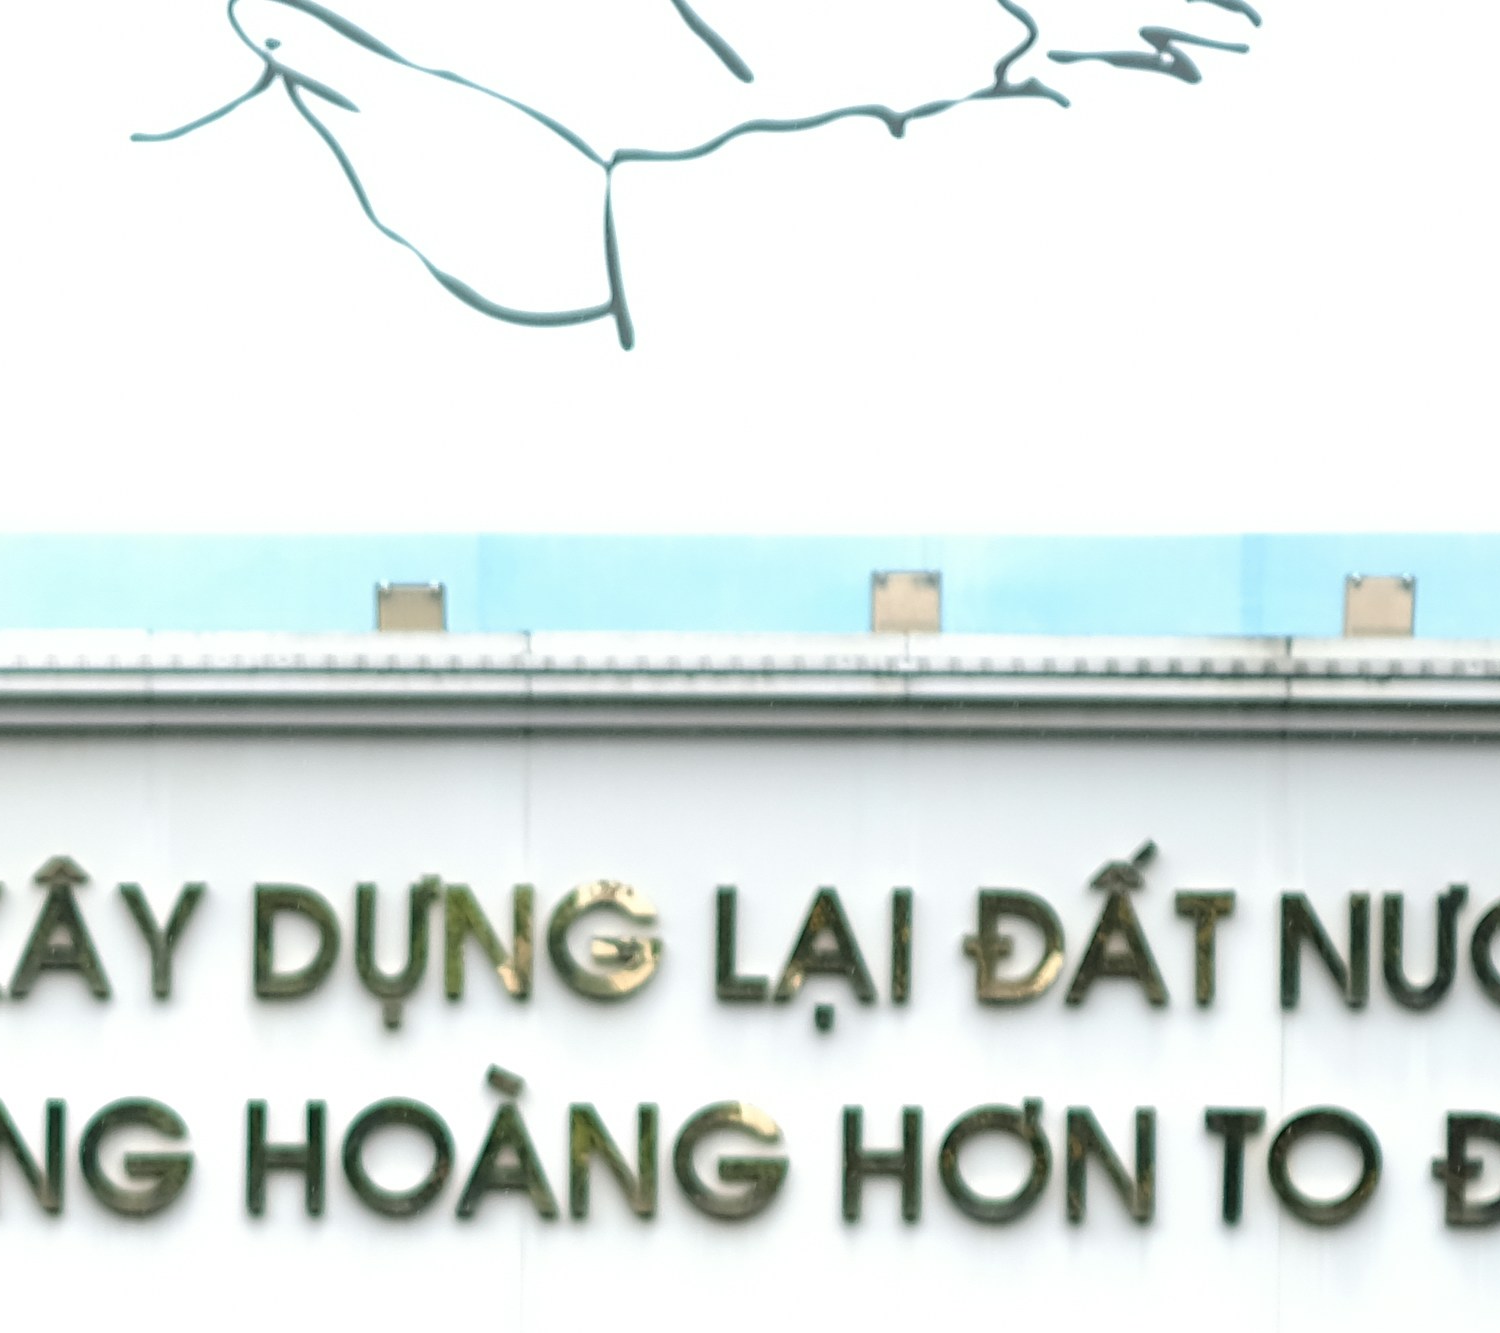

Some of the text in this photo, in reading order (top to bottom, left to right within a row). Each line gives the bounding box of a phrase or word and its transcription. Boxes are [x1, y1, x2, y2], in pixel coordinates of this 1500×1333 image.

[253, 873, 663, 1030] DỰNG
[714, 885, 913, 1031] LẠI
[961, 840, 1237, 1008] ĐẤT
[246, 1062, 791, 1219] HOÀNG
[842, 1096, 1157, 1226] HƠN
[1204, 1103, 1383, 1227] TO
